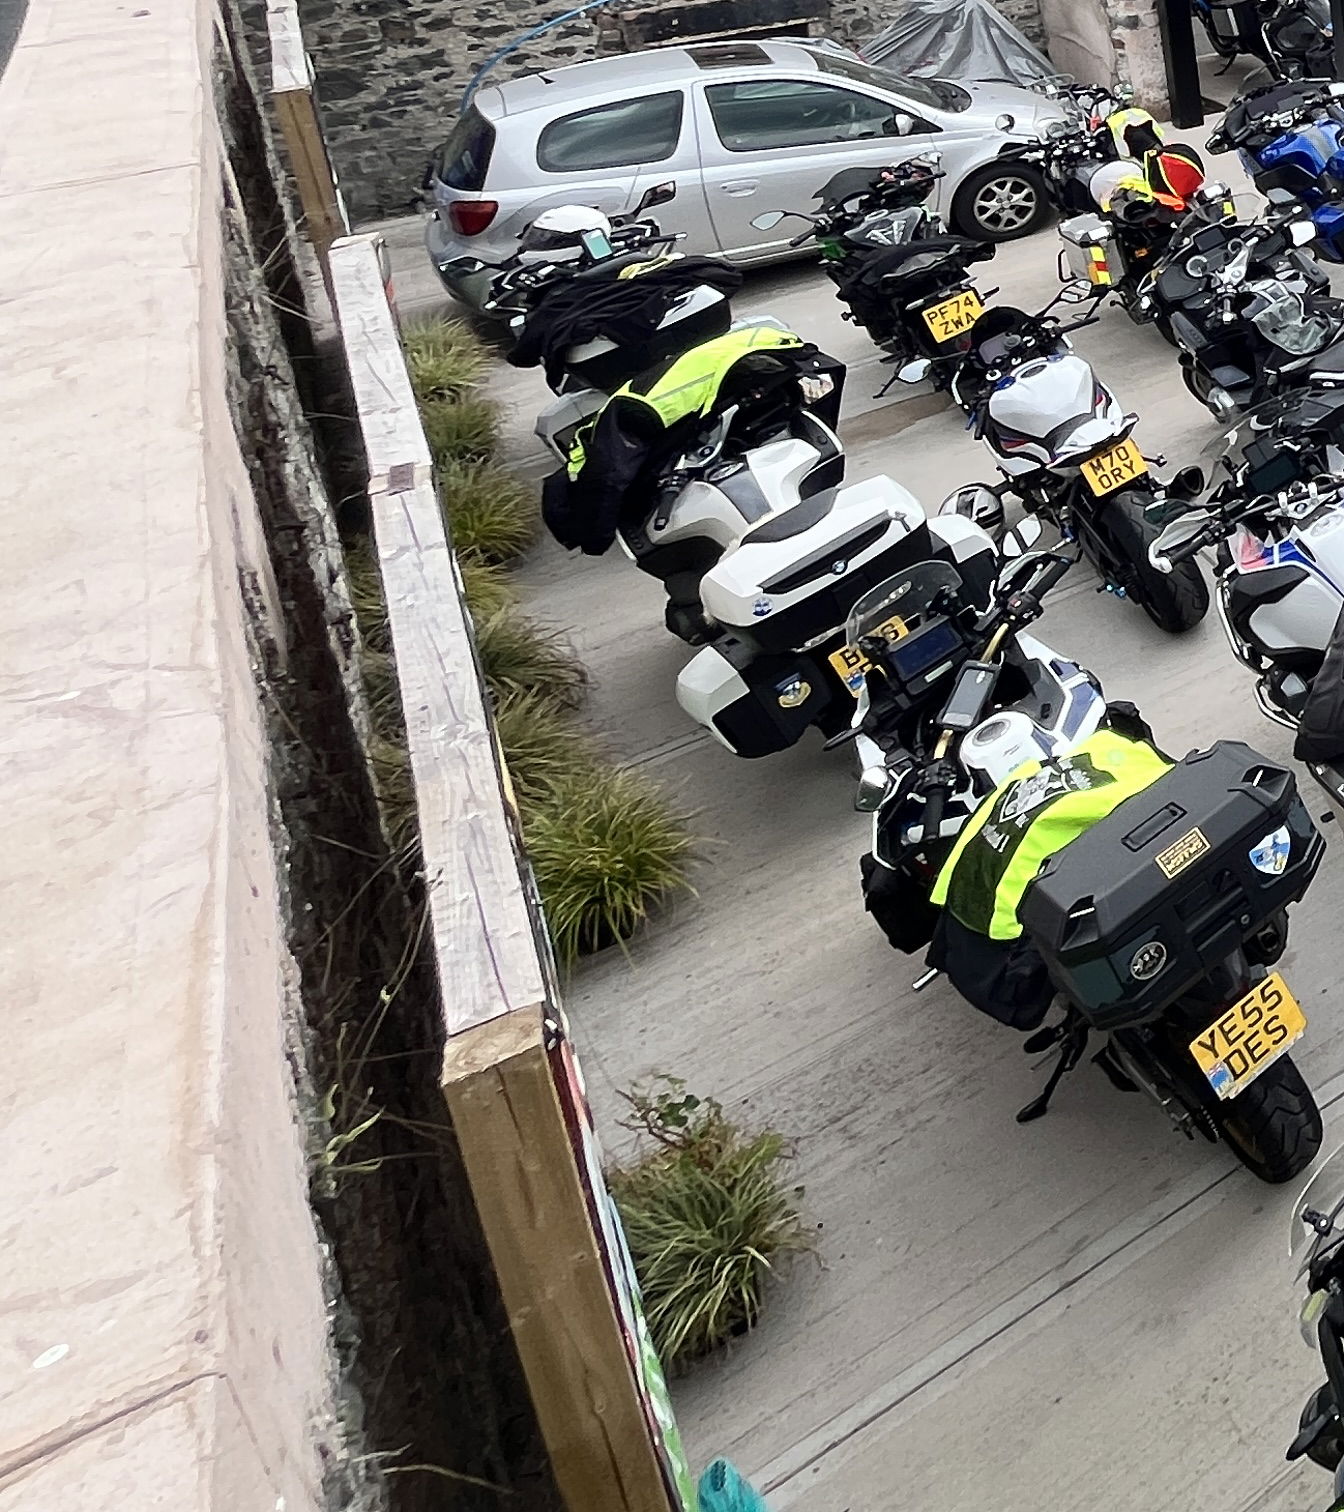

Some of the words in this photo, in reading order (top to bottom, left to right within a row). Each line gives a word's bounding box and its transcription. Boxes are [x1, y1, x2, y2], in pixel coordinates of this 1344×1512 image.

[926, 295, 974, 326] PF74
[938, 311, 976, 336] ZWA
[1088, 445, 1130, 477] M70
[1097, 459, 1136, 490] ORY
[1197, 978, 1283, 1059] YE55
[1222, 1014, 1288, 1081] DES
